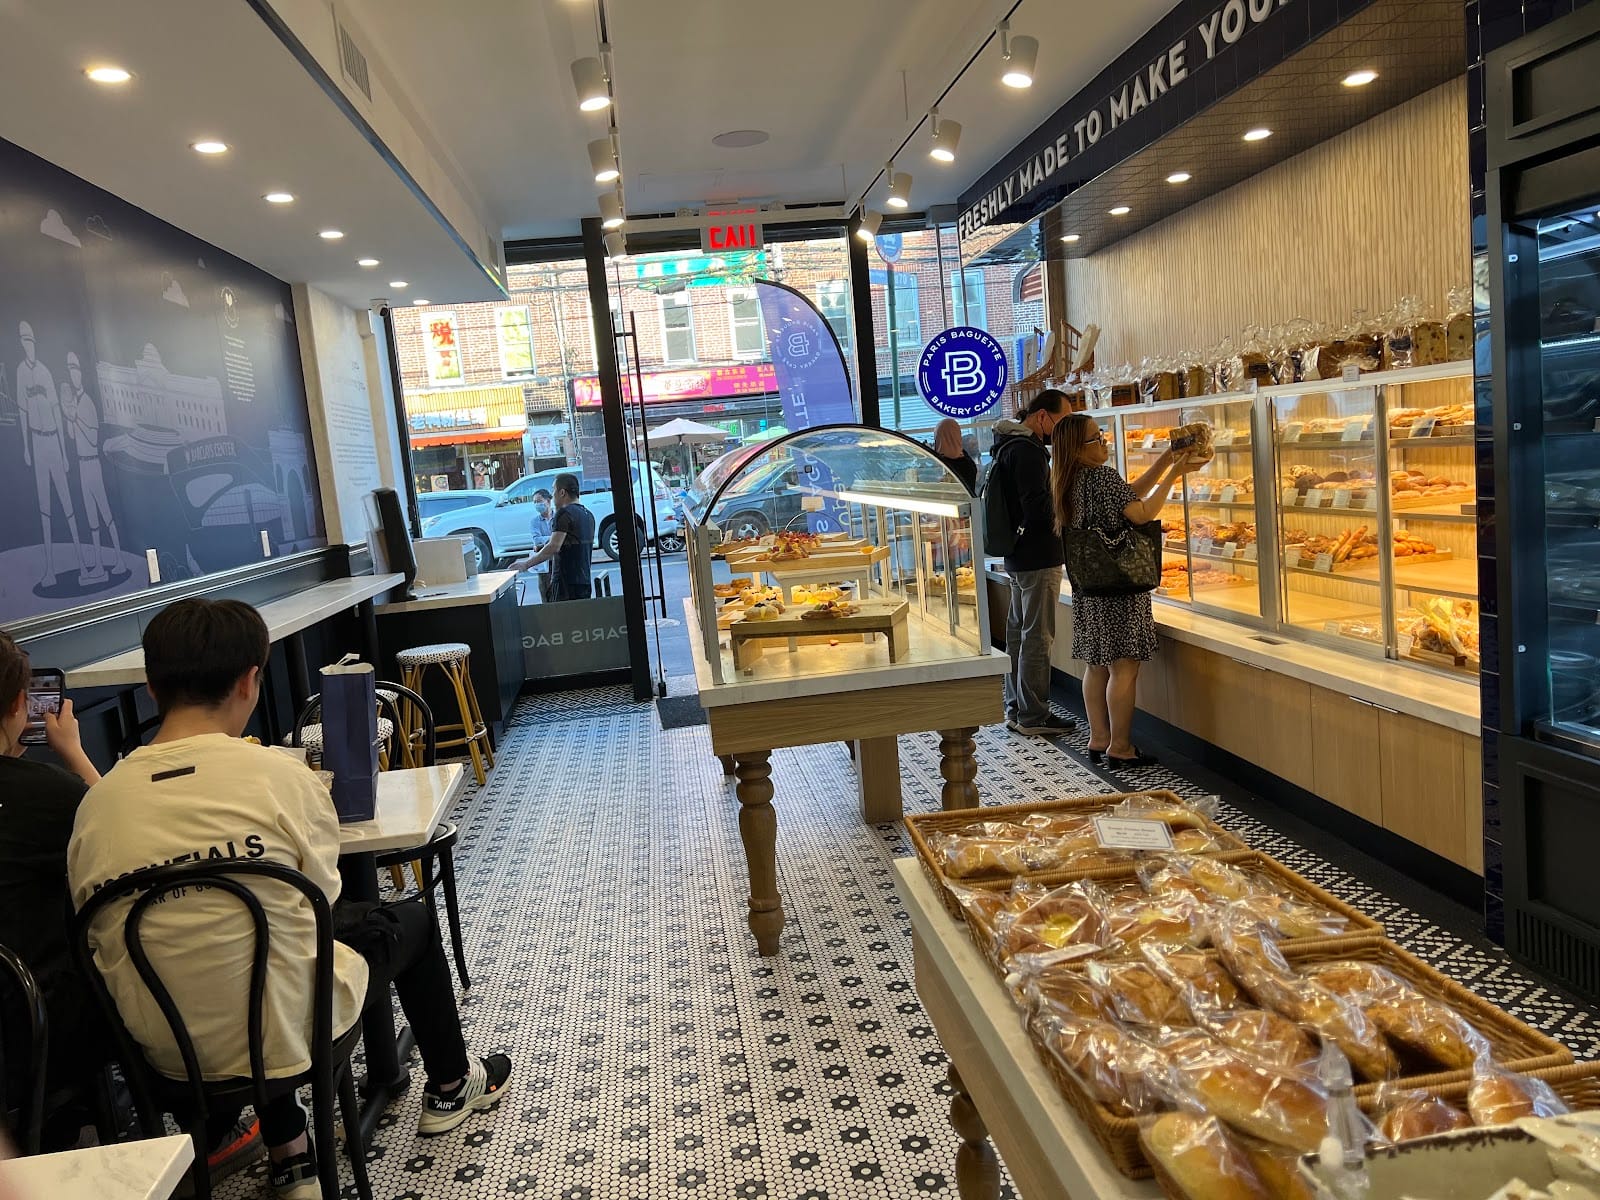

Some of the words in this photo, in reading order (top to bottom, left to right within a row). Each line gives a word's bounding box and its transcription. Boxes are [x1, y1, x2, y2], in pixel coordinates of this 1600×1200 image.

[958, 177, 1016, 242] FRESHLY
[1019, 134, 1070, 198] MADE
[1074, 109, 1103, 153] TO
[1110, 40, 1189, 129] MAKE
[1198, 0, 1289, 59] YOU
[923, 336, 947, 367] PARIS
[950, 330, 1002, 361] BAGUETTE
[931, 395, 971, 415] BAKERY
[973, 389, 999, 412] CAFÉ
[434, 1100, 456, 1110] "AIR"
